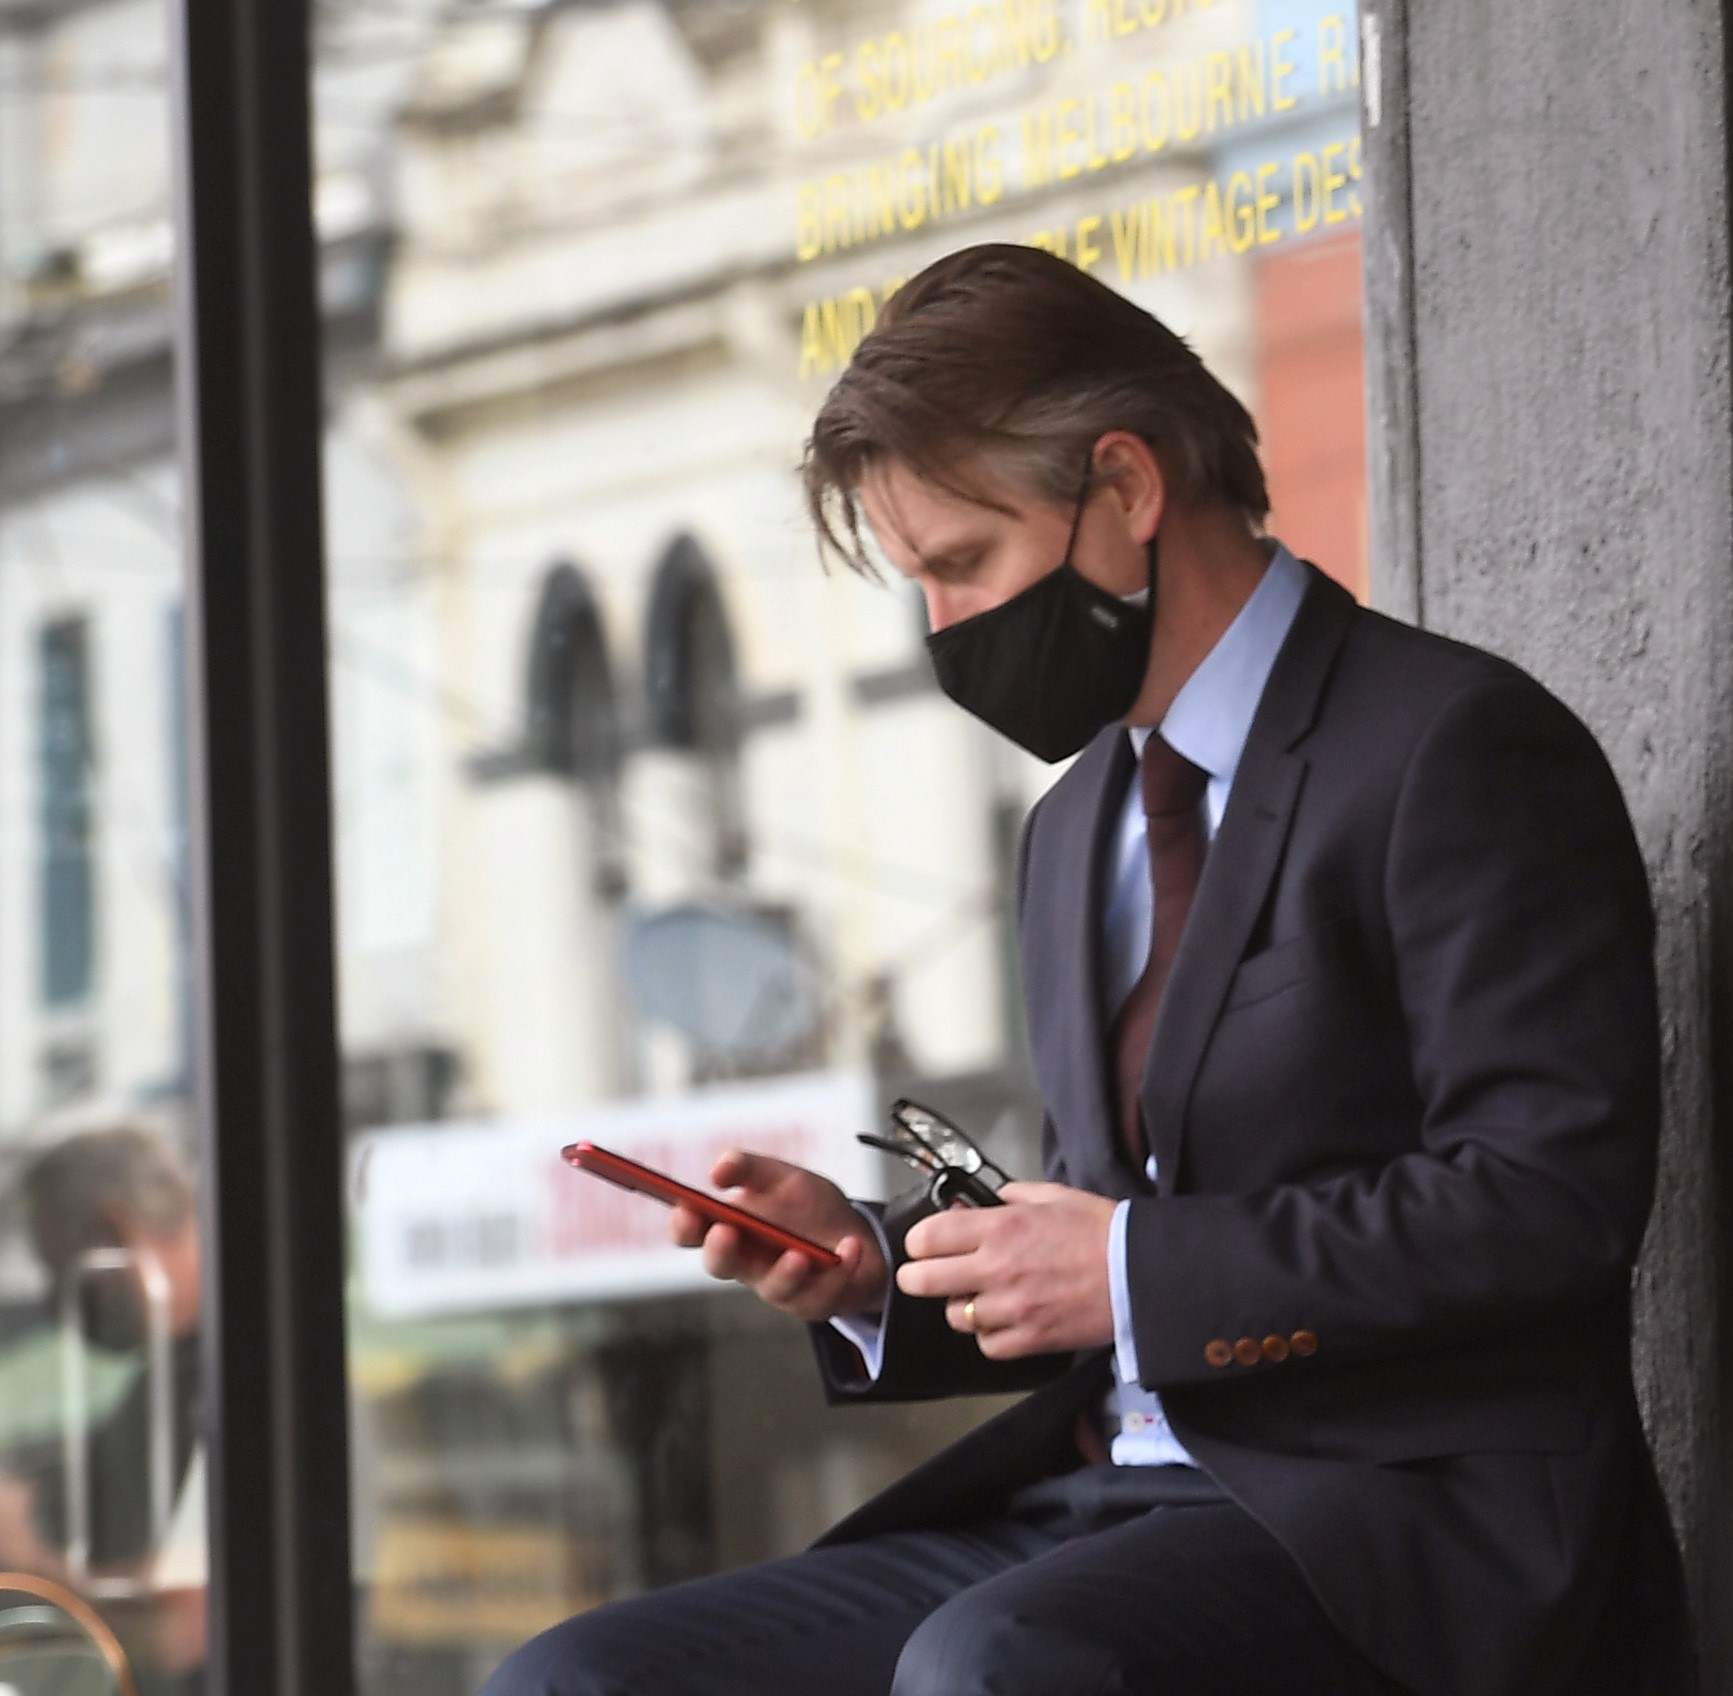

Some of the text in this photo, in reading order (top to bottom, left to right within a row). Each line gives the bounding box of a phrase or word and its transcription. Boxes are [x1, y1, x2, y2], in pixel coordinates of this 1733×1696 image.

[797, 126, 1004, 262] BRINGING
[1022, 28, 1297, 189] MELBOURNE
[1110, 163, 1281, 284] VINTAGE
